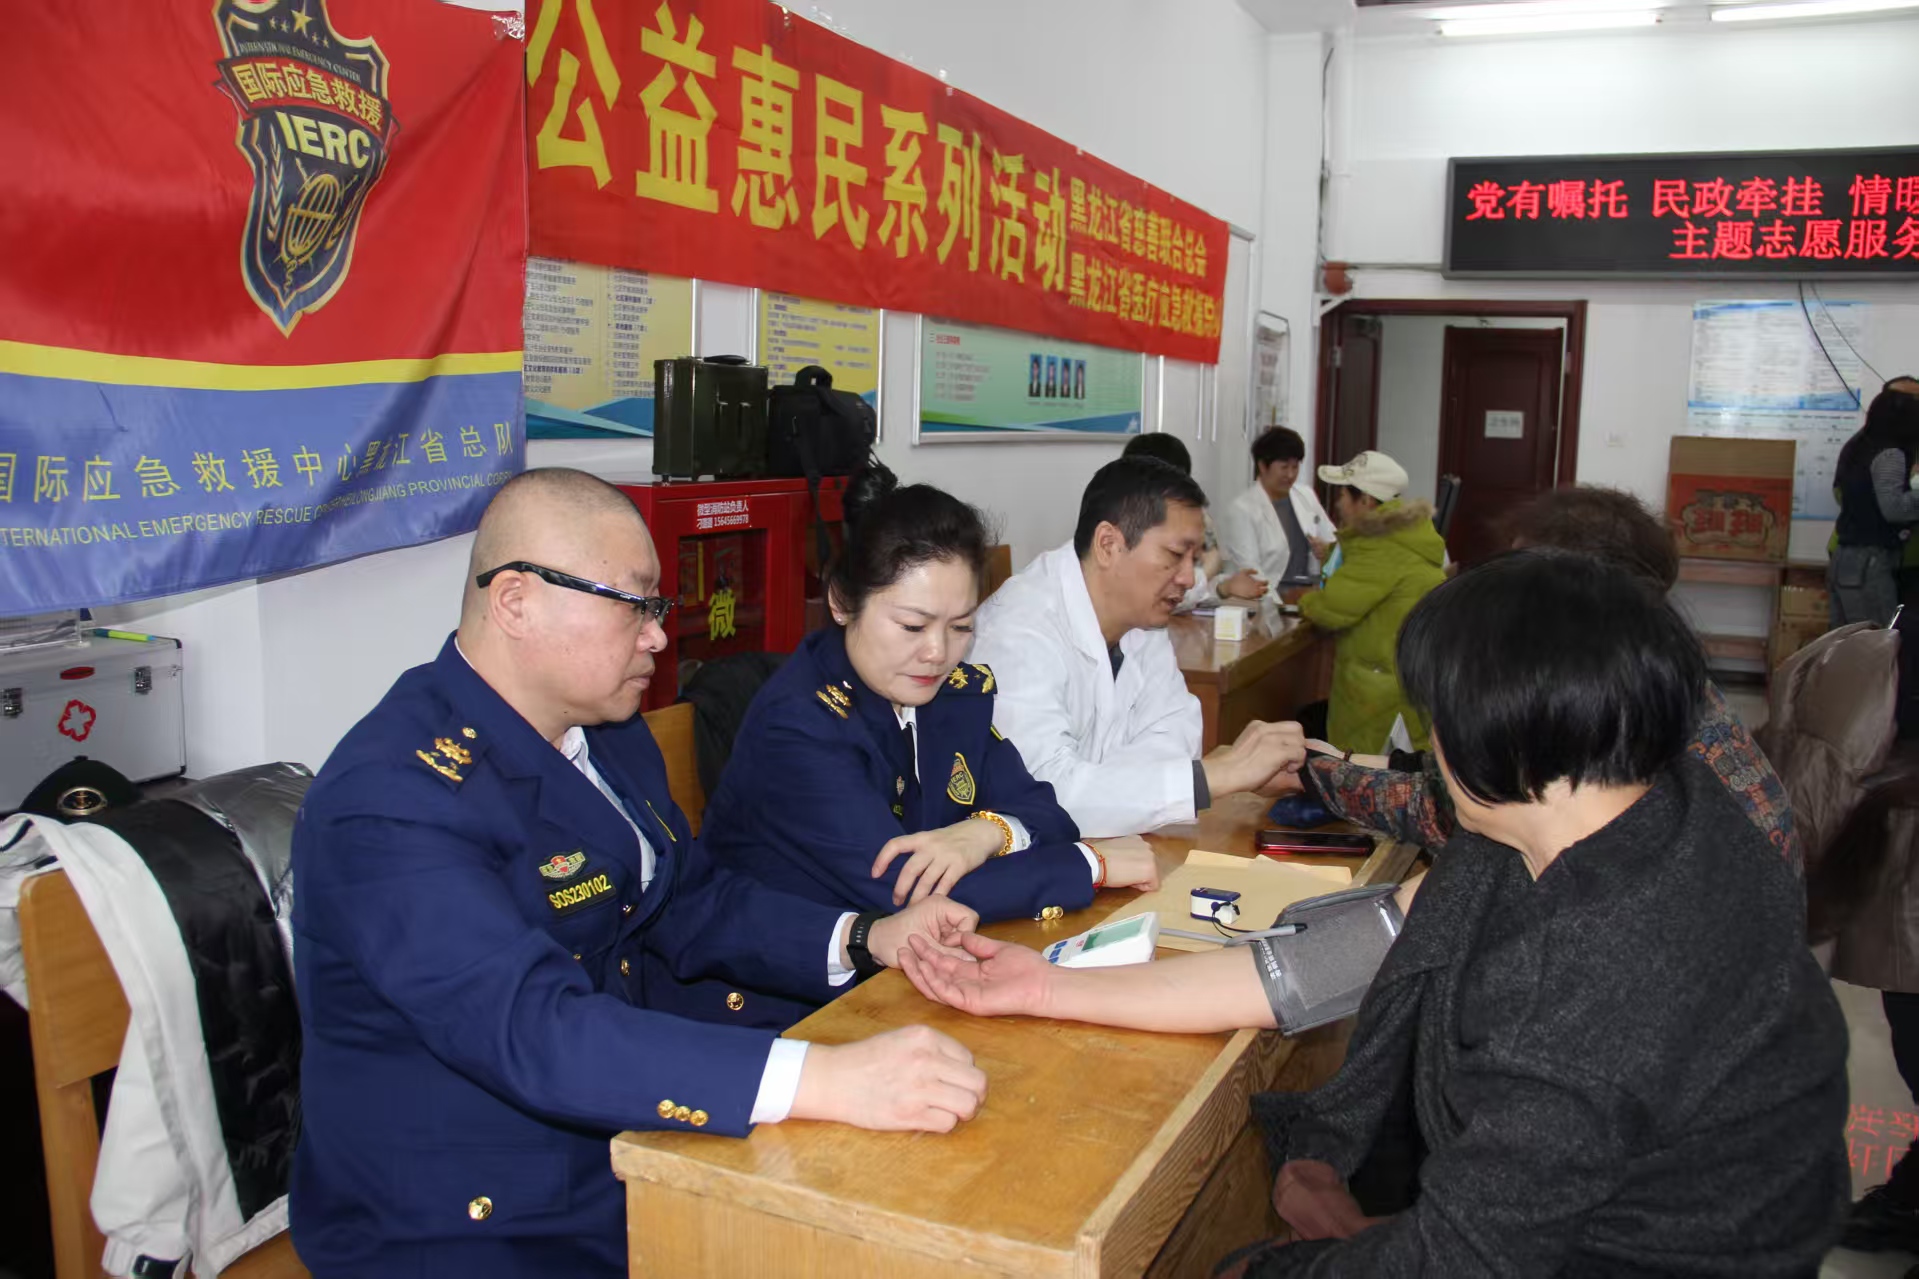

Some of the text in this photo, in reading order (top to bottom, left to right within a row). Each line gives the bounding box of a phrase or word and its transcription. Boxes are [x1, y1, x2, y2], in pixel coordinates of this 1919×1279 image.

[232, 61, 383, 132] 国际应急救援
[275, 110, 371, 169] IERC
[526, 0, 1066, 292] 公益惠民系列活动
[1466, 179, 1629, 221] 党有嘱托
[1652, 175, 1824, 219] 民政牵挂
[1668, 217, 1919, 261] 主题志愿服务
[138, 511, 253, 538] EMERGENCY
[255, 505, 311, 525] RESCUE
[409, 473, 485, 497] PROVINCIAL
[549, 874, 612, 909] SOS230102
